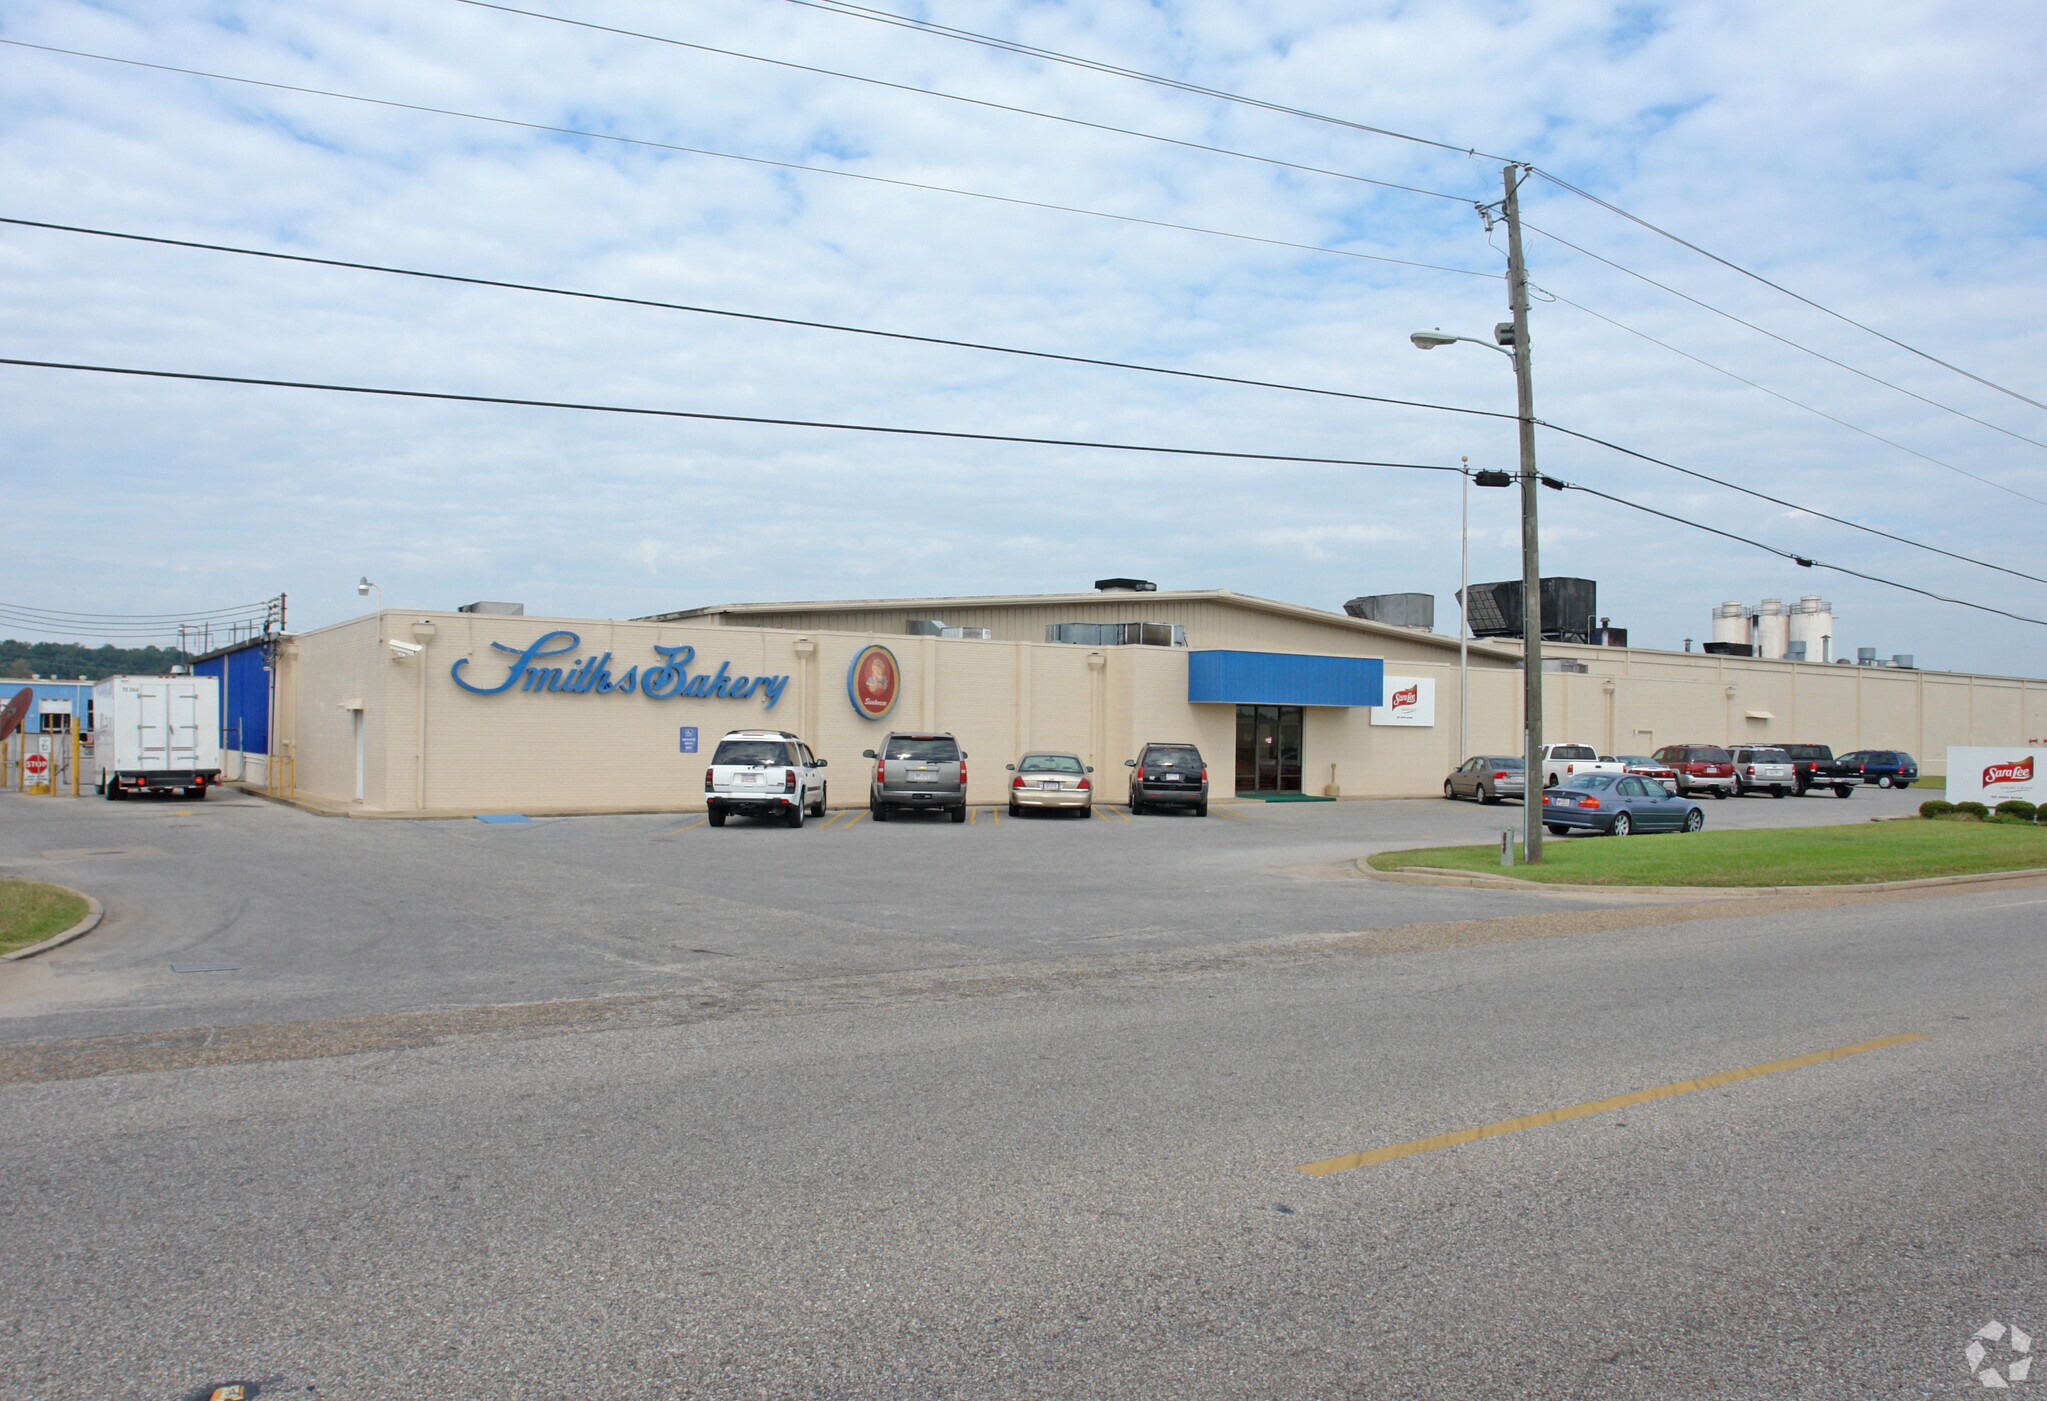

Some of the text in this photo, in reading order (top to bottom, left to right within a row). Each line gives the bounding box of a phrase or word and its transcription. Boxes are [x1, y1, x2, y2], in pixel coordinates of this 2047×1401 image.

[451, 630, 790, 711] Smiths Bakery
[1393, 692, 1416, 706] Sara Lee
[1985, 766, 2031, 782] Sara Lee
